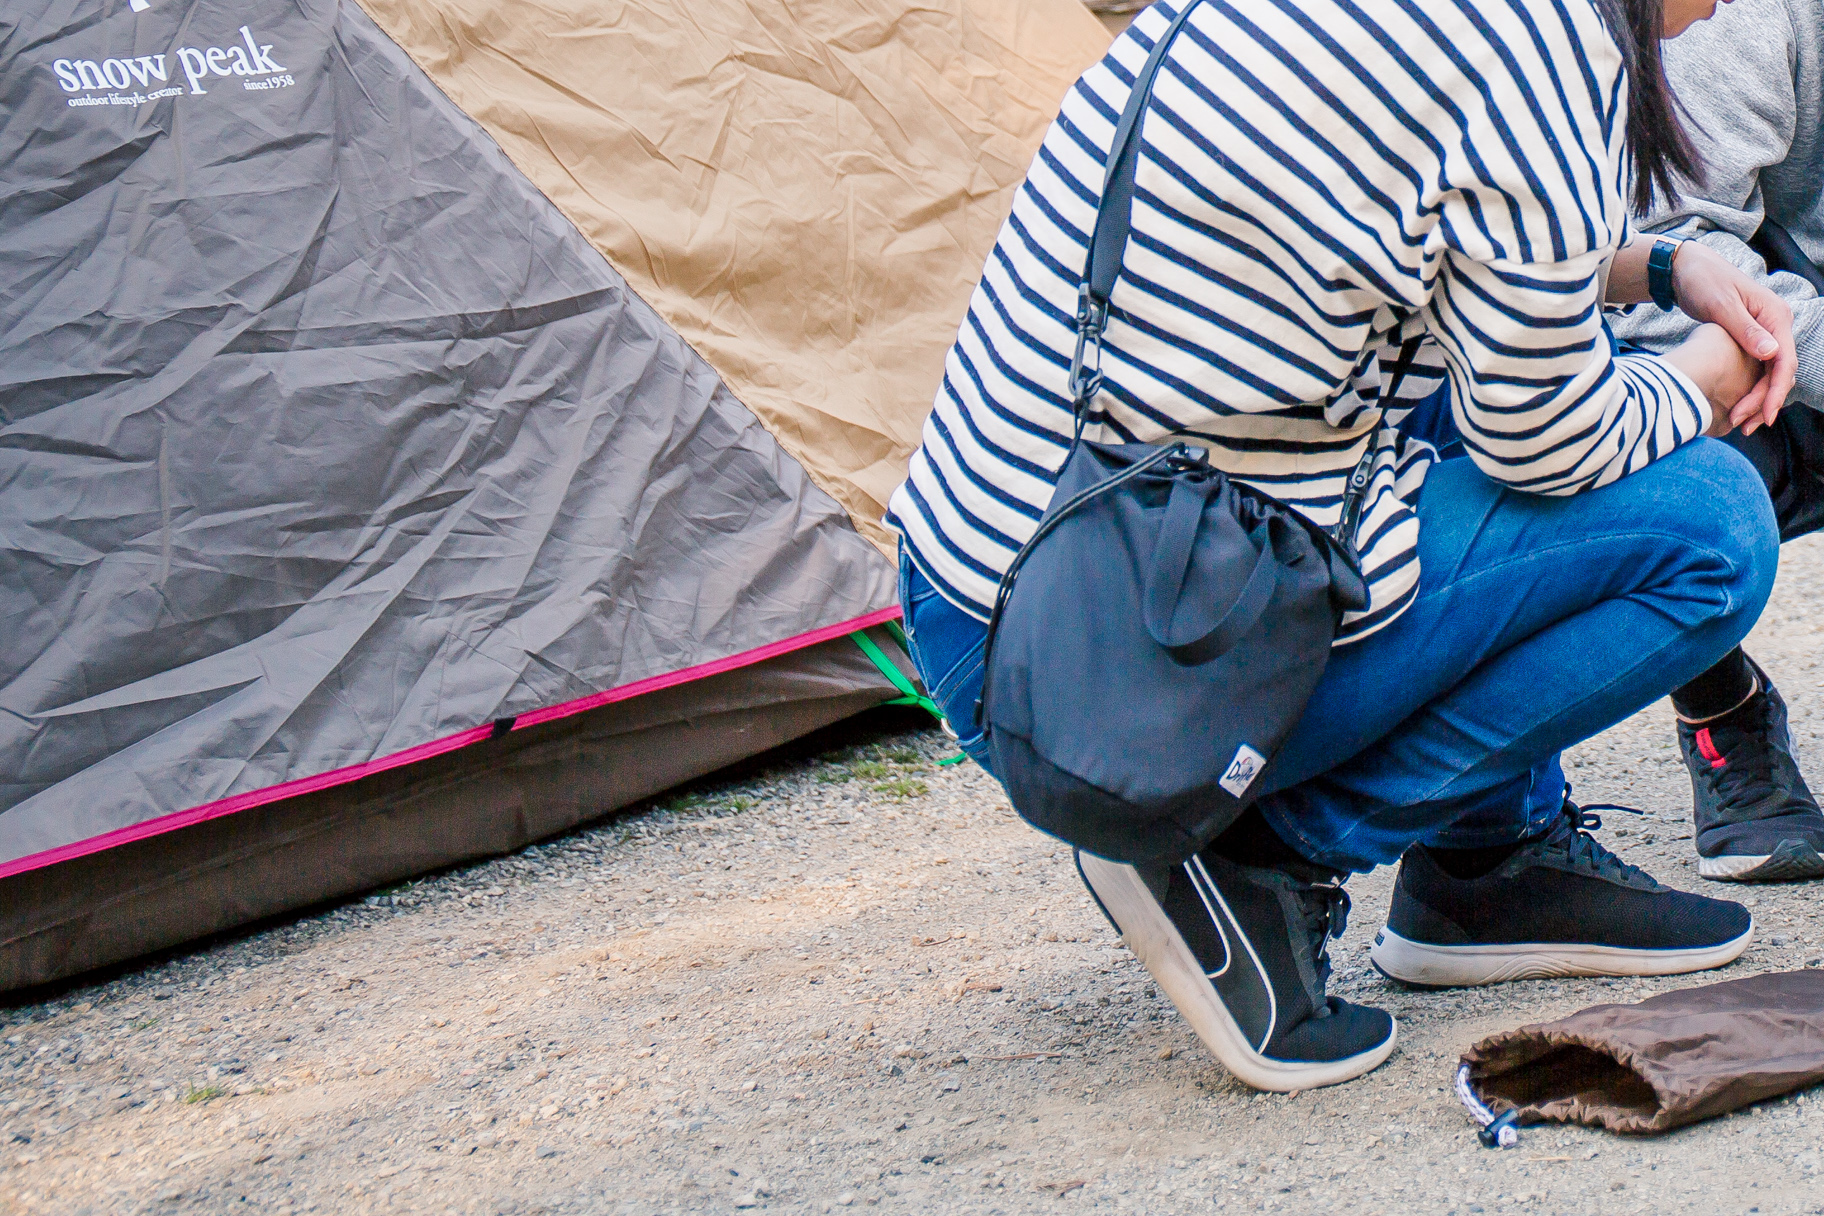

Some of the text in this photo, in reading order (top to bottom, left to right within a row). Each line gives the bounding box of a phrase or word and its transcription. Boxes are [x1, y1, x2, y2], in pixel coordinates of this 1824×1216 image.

[52, 25, 288, 95] snow peak
[67, 86, 184, 108] outdoor lifestyle creator
